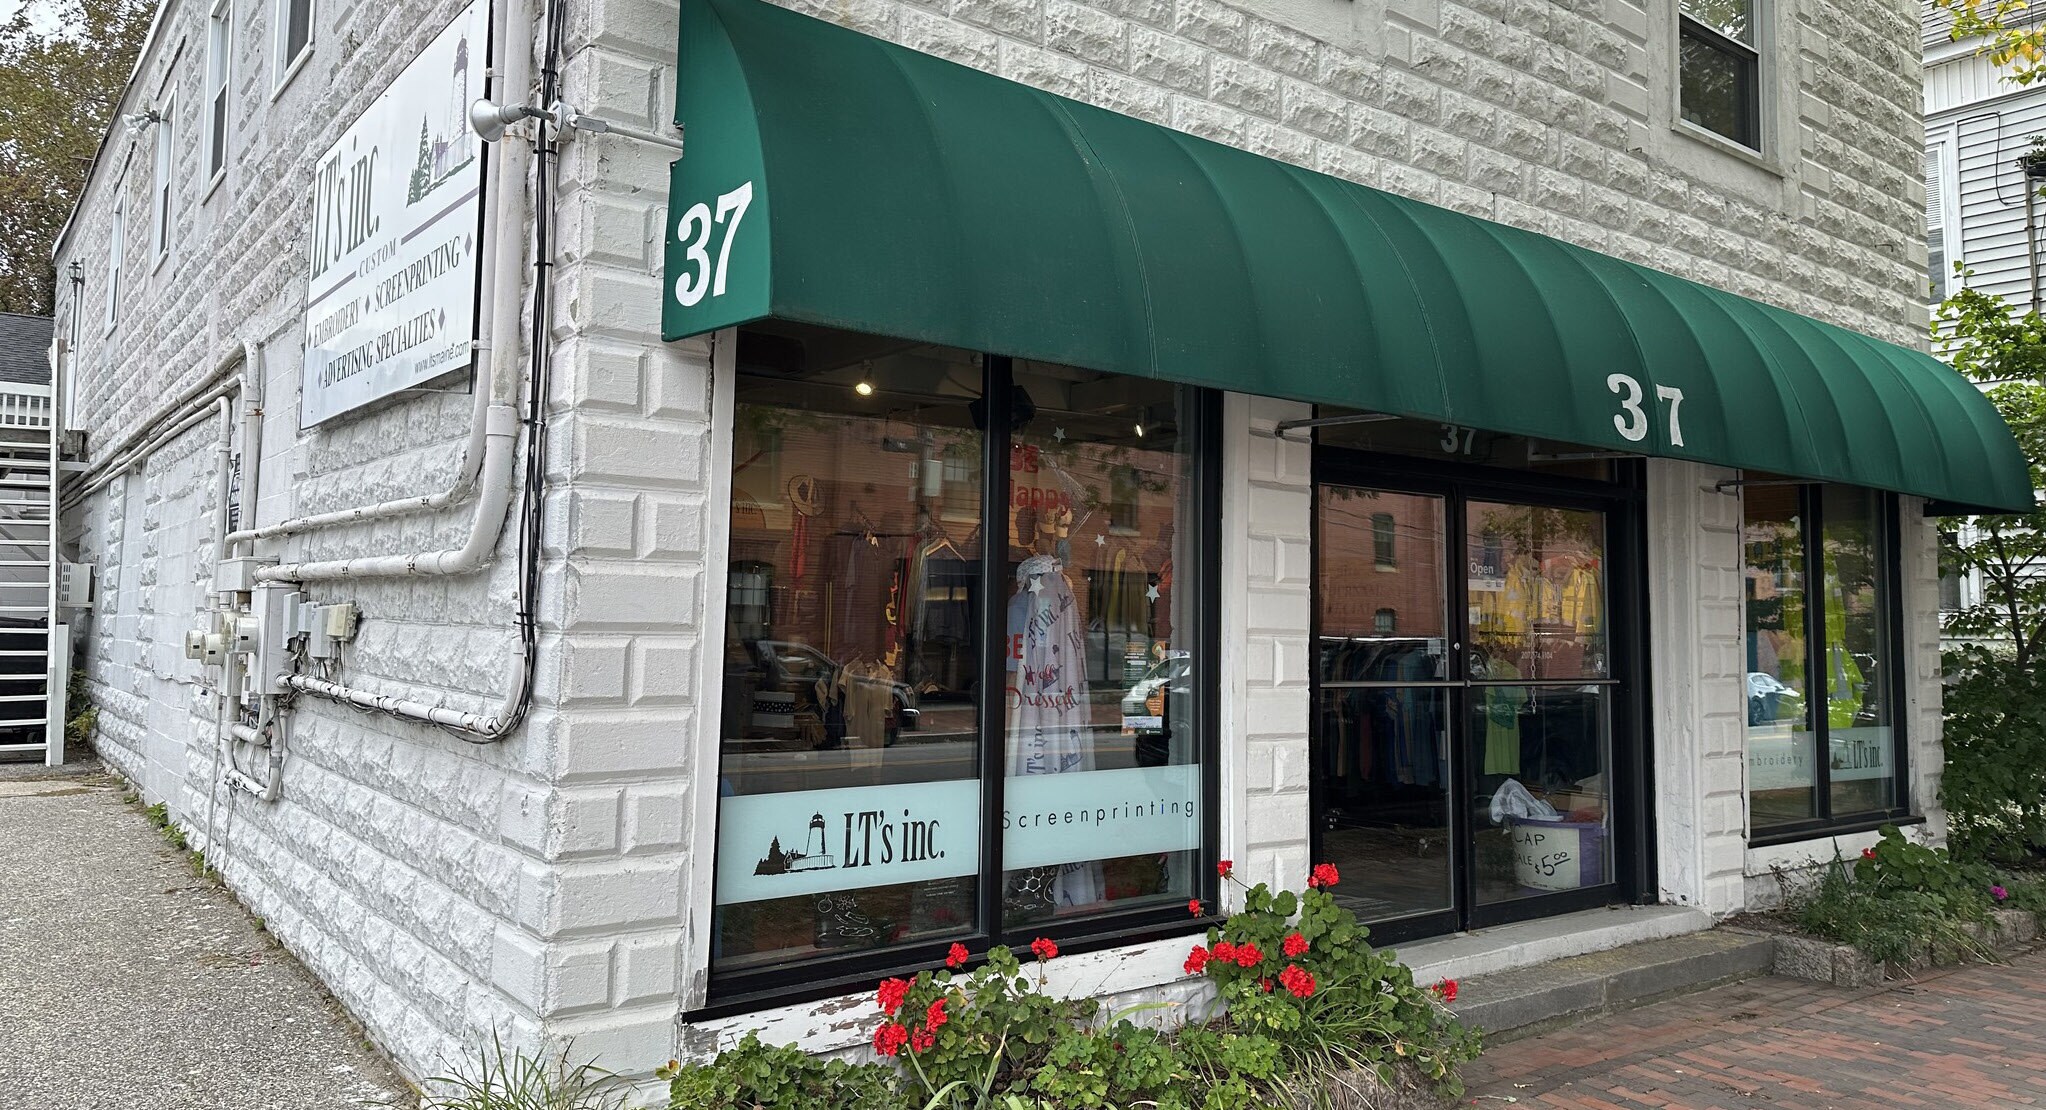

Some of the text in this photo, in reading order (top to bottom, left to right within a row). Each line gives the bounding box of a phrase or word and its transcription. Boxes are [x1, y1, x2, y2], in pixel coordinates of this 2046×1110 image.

[311, 134, 379, 282] LT's inc.
[359, 237, 397, 278] CUSTOM
[675, 180, 753, 307] 37
[313, 235, 461, 348] EMBROIDERY SCREENPRINTING
[323, 308, 436, 389] ADVERTISING SPECIALTIES
[1607, 373, 1684, 447] 37
[1440, 423, 1477, 455] 37
[1470, 562, 1494, 576] Open
[1749, 752, 1803, 768] mbroidery
[1853, 740, 1883, 769] LT's inc.
[1002, 799, 1194, 830] Screenprinting
[1514, 823, 1545, 846] CAP
[842, 808, 945, 868] LT's inc.
